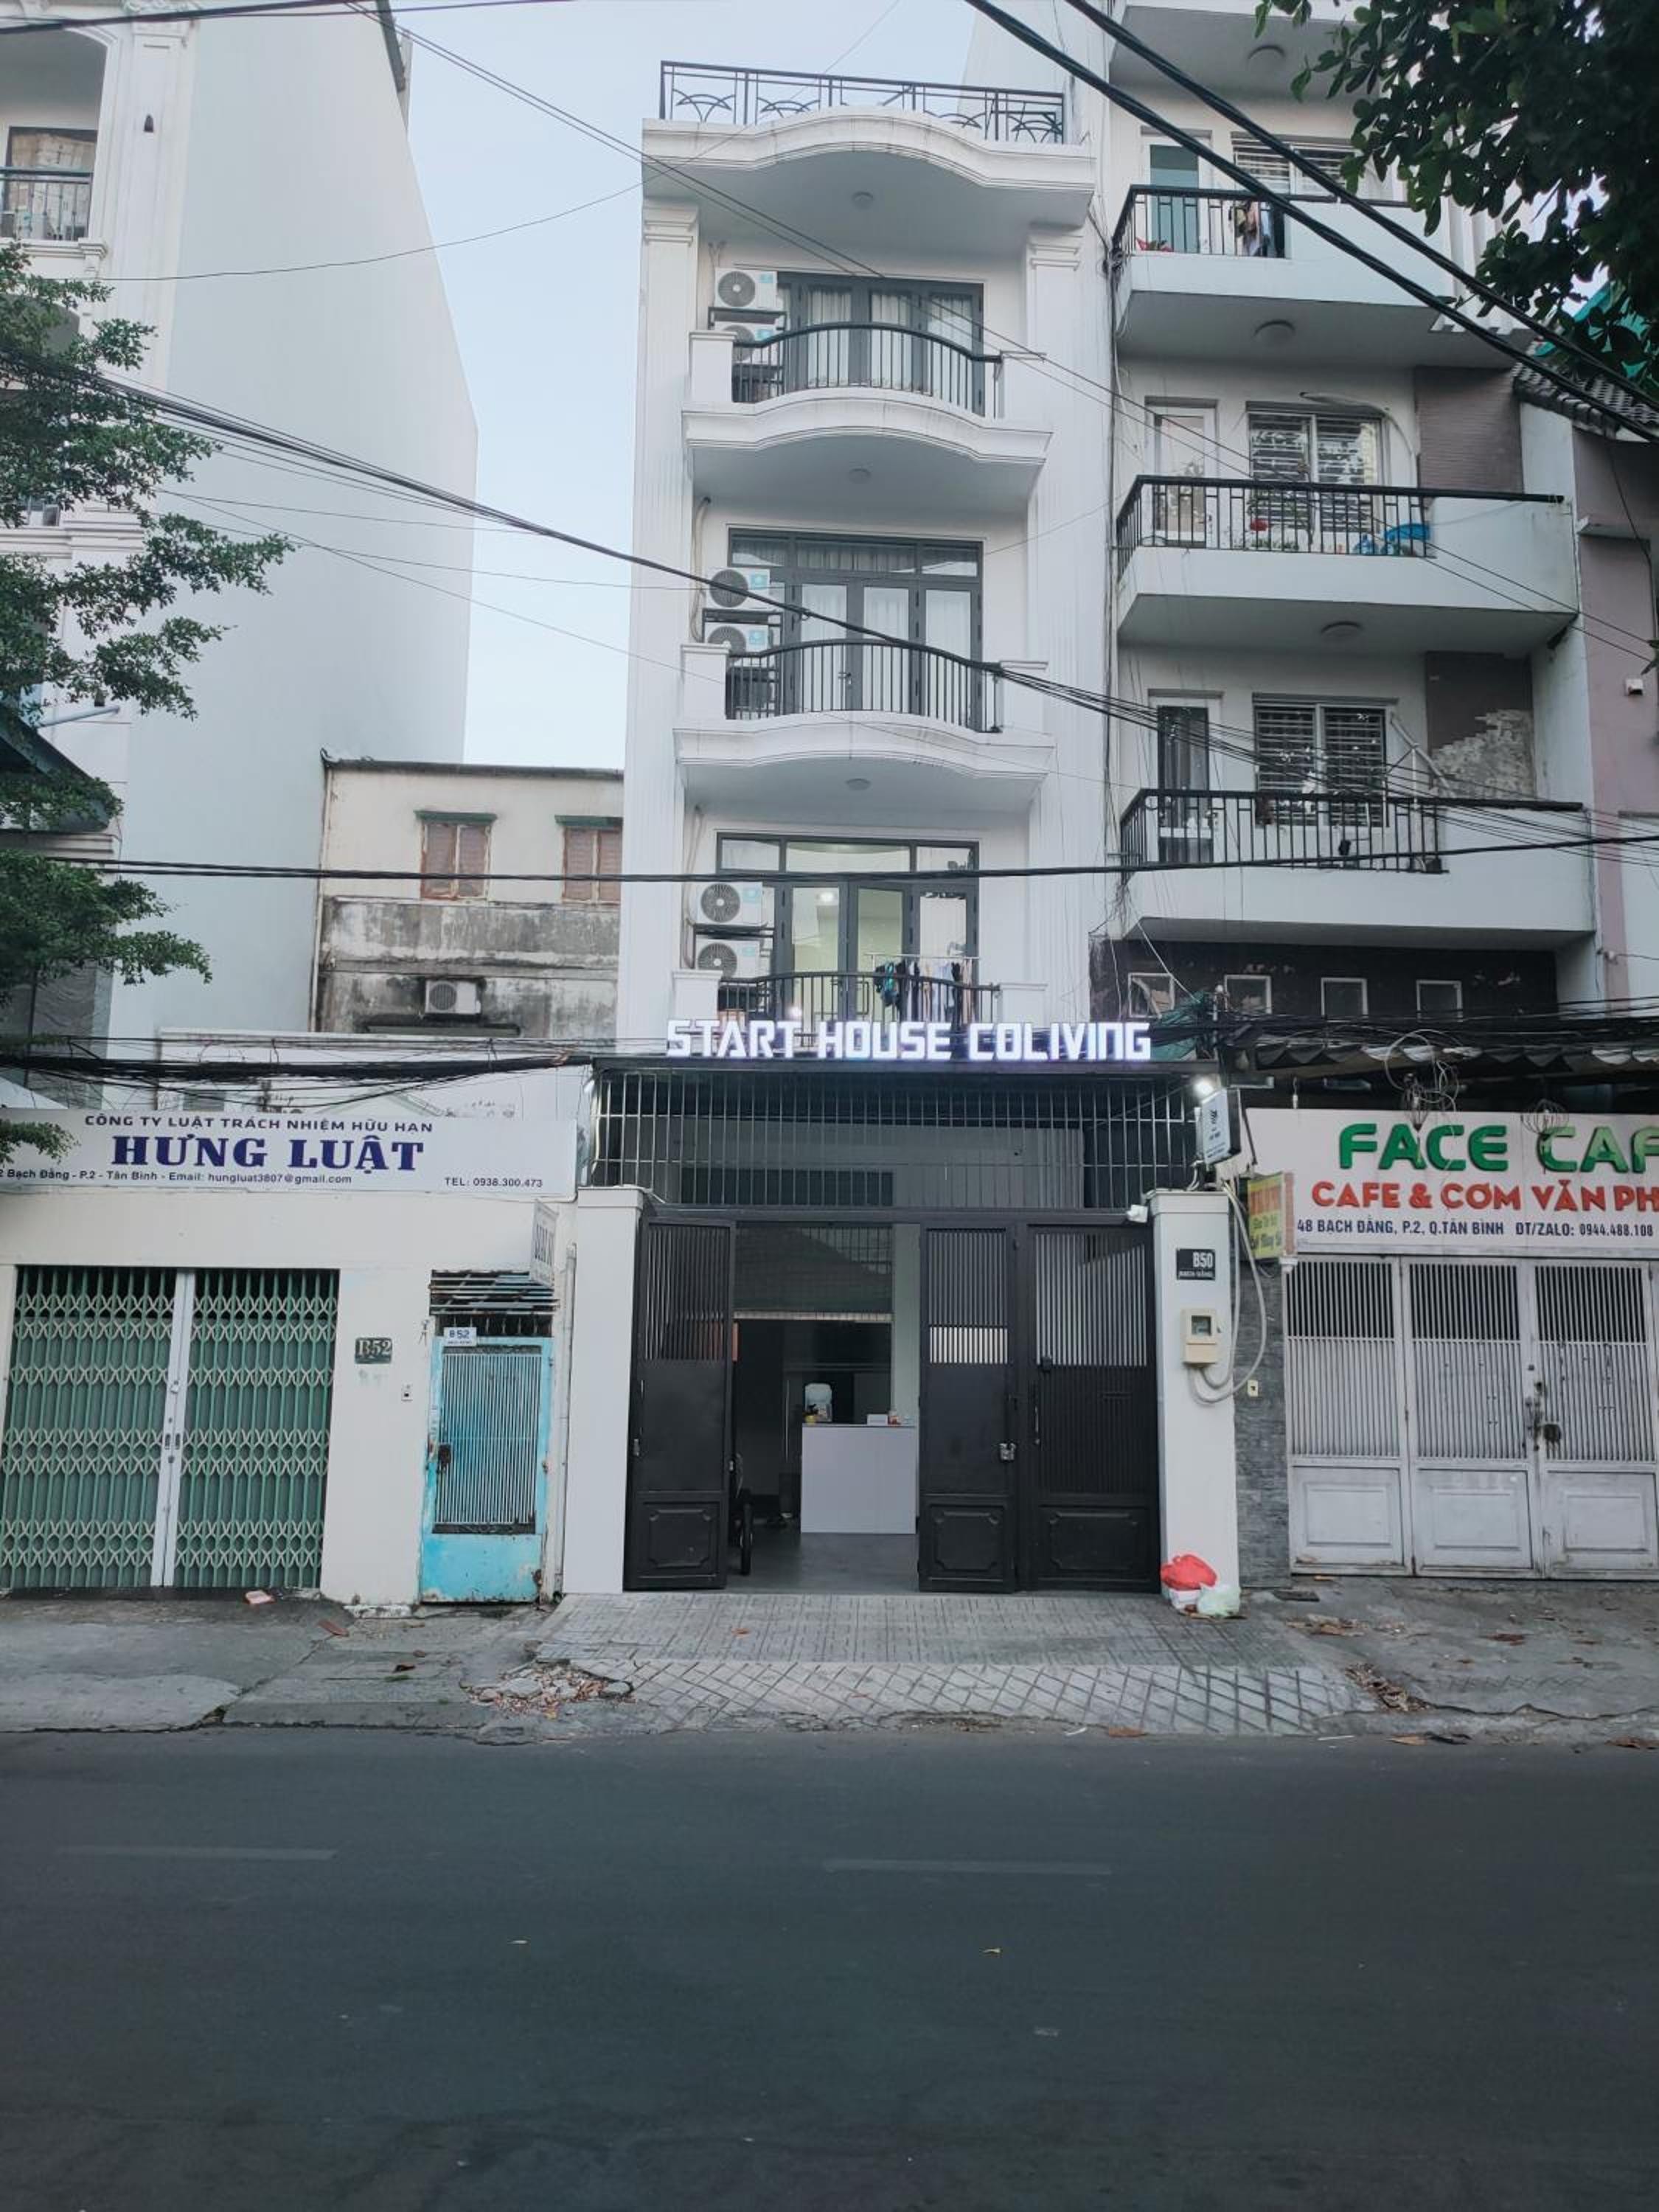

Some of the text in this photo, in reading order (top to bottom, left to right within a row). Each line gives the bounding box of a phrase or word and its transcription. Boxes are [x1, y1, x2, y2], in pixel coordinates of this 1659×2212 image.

[665, 1020, 1152, 1062] START HOUSE COLIVING
[85, 1113, 434, 1135] CÔNG TY LUẬT TRÁCH NHIỆM HỮU HẠN
[111, 1134, 424, 1174] HƯNG LUẬT
[1338, 1123, 1509, 1172] FACE
[7, 1169, 36, 1180] Bạch
[79, 1170, 96, 1180] P.2
[106, 1170, 128, 1180] Tân
[131, 1170, 157, 1180] Bình
[169, 1171, 205, 1181] Email:
[444, 1177, 470, 1186] TEL:
[1311, 1181, 1401, 1208] CAFE
[1408, 1183, 1433, 1209] &
[1440, 1183, 1522, 1211] CƠM
[1531, 1180, 1607, 1212] VĂN
[1317, 1220, 1353, 1234] BẠCH
[1402, 1220, 1425, 1235] P.2,
[1429, 1218, 1467, 1236] Q.TÂN
[1472, 1219, 1504, 1234] BÌNH
[1515, 1222, 1575, 1237] ĐT/ZALO:
[1193, 1252, 1213, 1268] B50
[358, 1340, 392, 1356] B52
